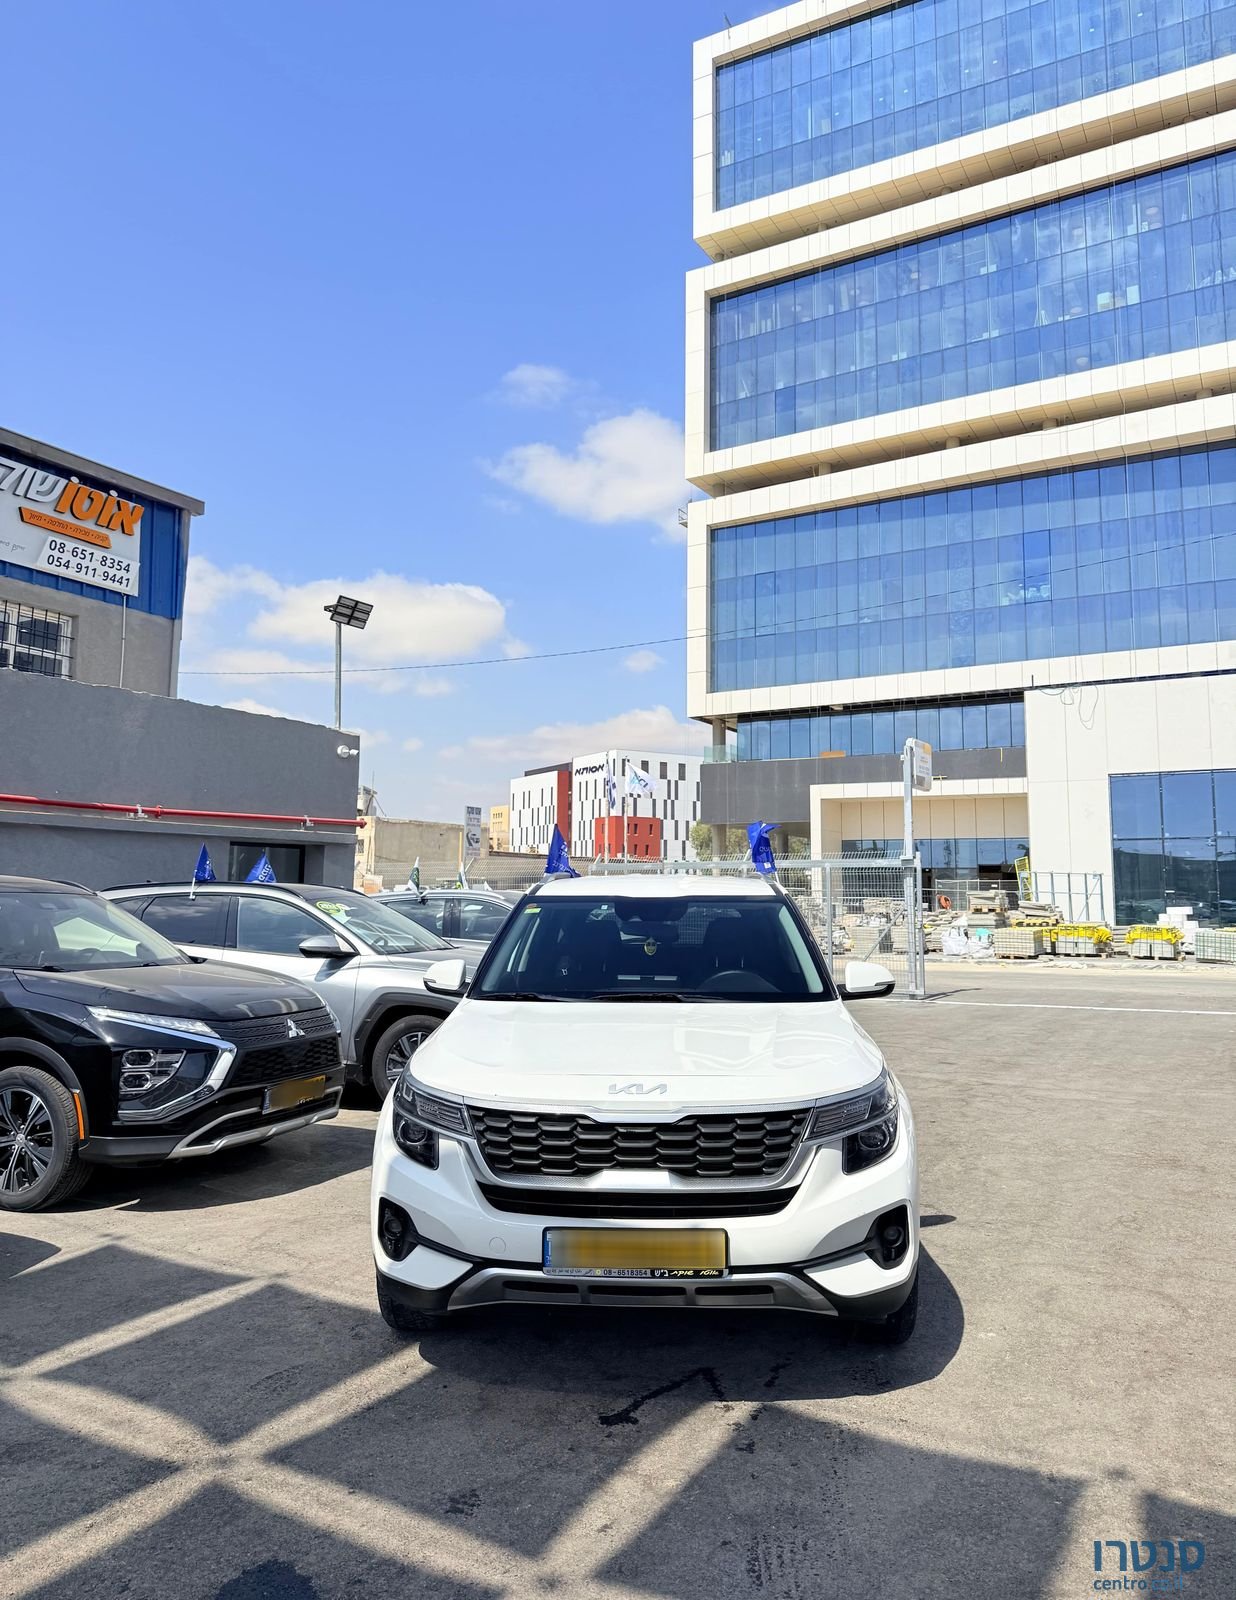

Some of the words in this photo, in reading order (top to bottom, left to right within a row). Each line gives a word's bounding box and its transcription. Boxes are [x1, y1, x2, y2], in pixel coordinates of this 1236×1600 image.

[49, 540, 131, 573] 08-651-8354
[47, 554, 130, 588] 054-911-9441
[575, 764, 605, 776] אסותא
[608, 1083, 667, 1095] KIA
